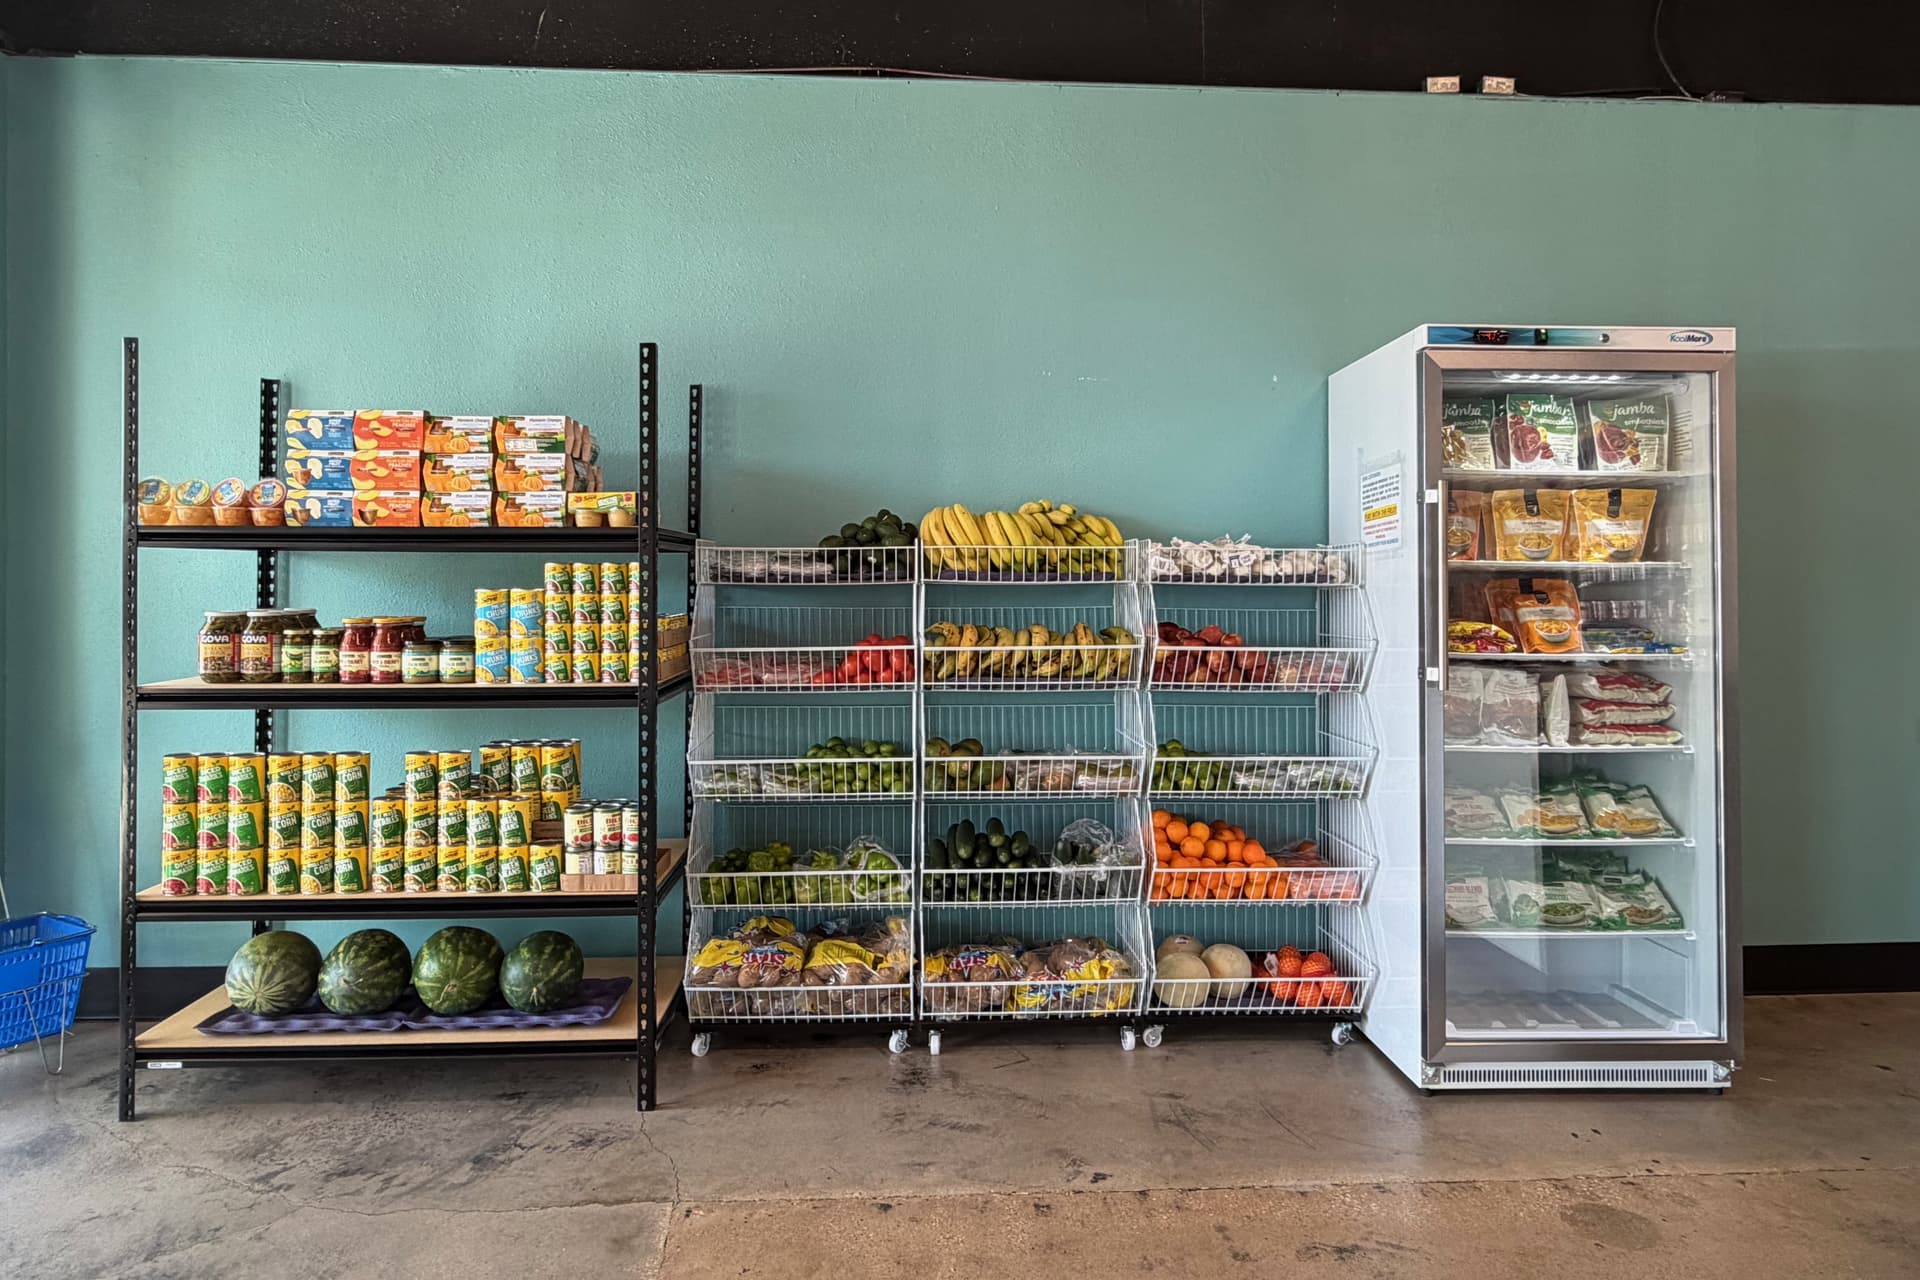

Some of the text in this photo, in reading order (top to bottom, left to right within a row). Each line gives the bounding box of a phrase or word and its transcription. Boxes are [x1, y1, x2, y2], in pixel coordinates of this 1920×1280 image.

[1670, 333, 1707, 343] KoolMore
[1444, 403, 1482, 420] jamba
[1610, 403, 1655, 421] jamba
[486, 606, 507, 619] CHUNK
[201, 635, 230, 644] GOYA
[241, 635, 268, 644] GOYA
[307, 769, 329, 783] CORN
[342, 769, 363, 783] CORN
[276, 815, 297, 829] CORN
[311, 815, 332, 829] CORN
[271, 862, 290, 876] CORN
[742, 951, 785, 965] STAR
